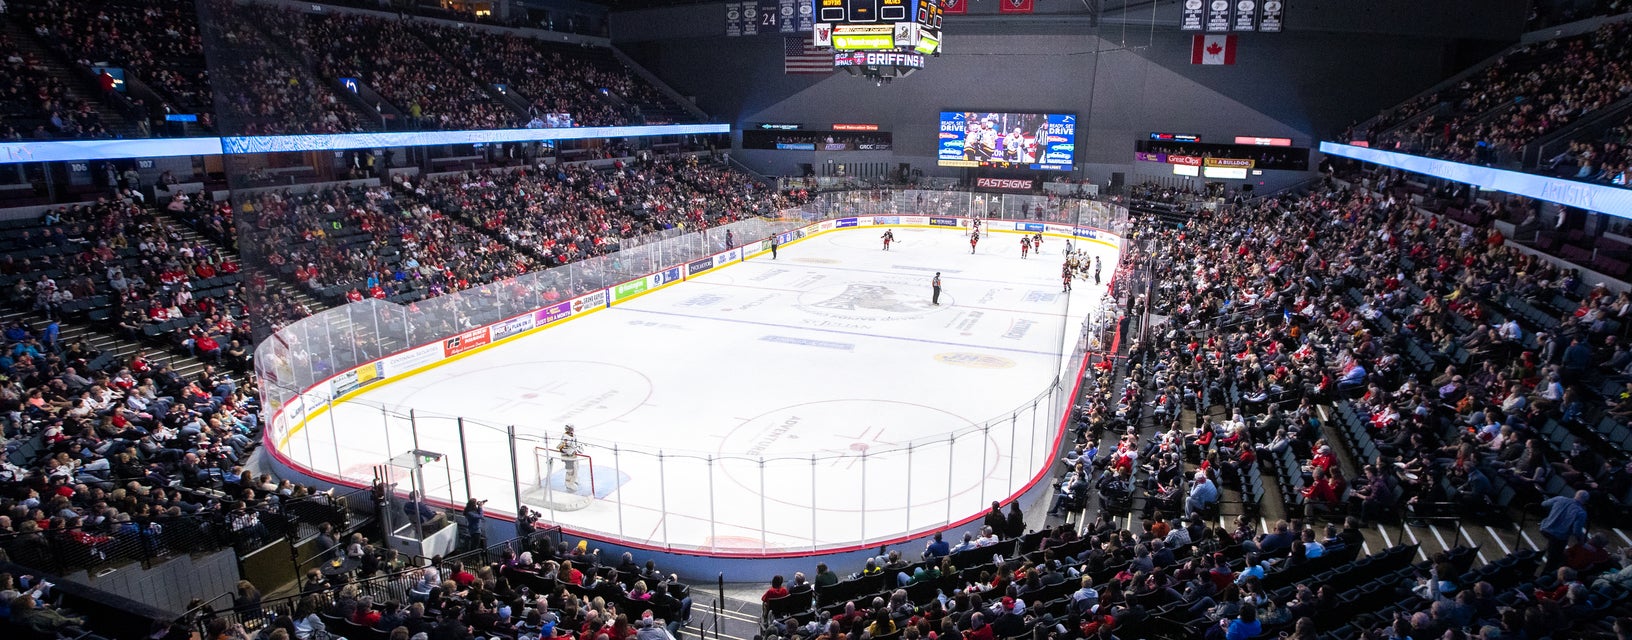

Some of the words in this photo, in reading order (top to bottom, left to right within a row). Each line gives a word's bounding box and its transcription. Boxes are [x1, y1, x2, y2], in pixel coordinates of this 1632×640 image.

[762, 13, 776, 25] 24
[867, 53, 919, 66] GRIFFINS
[139, 160, 153, 168] 107
[1169, 155, 1184, 163] Great
[1184, 156, 1199, 166] Clips
[72, 163, 87, 172] 106
[977, 178, 1033, 189] FASTSIGNS
[1541, 181, 1599, 206] ARTISTRY
[746, 415, 801, 457] ADVENTURE
